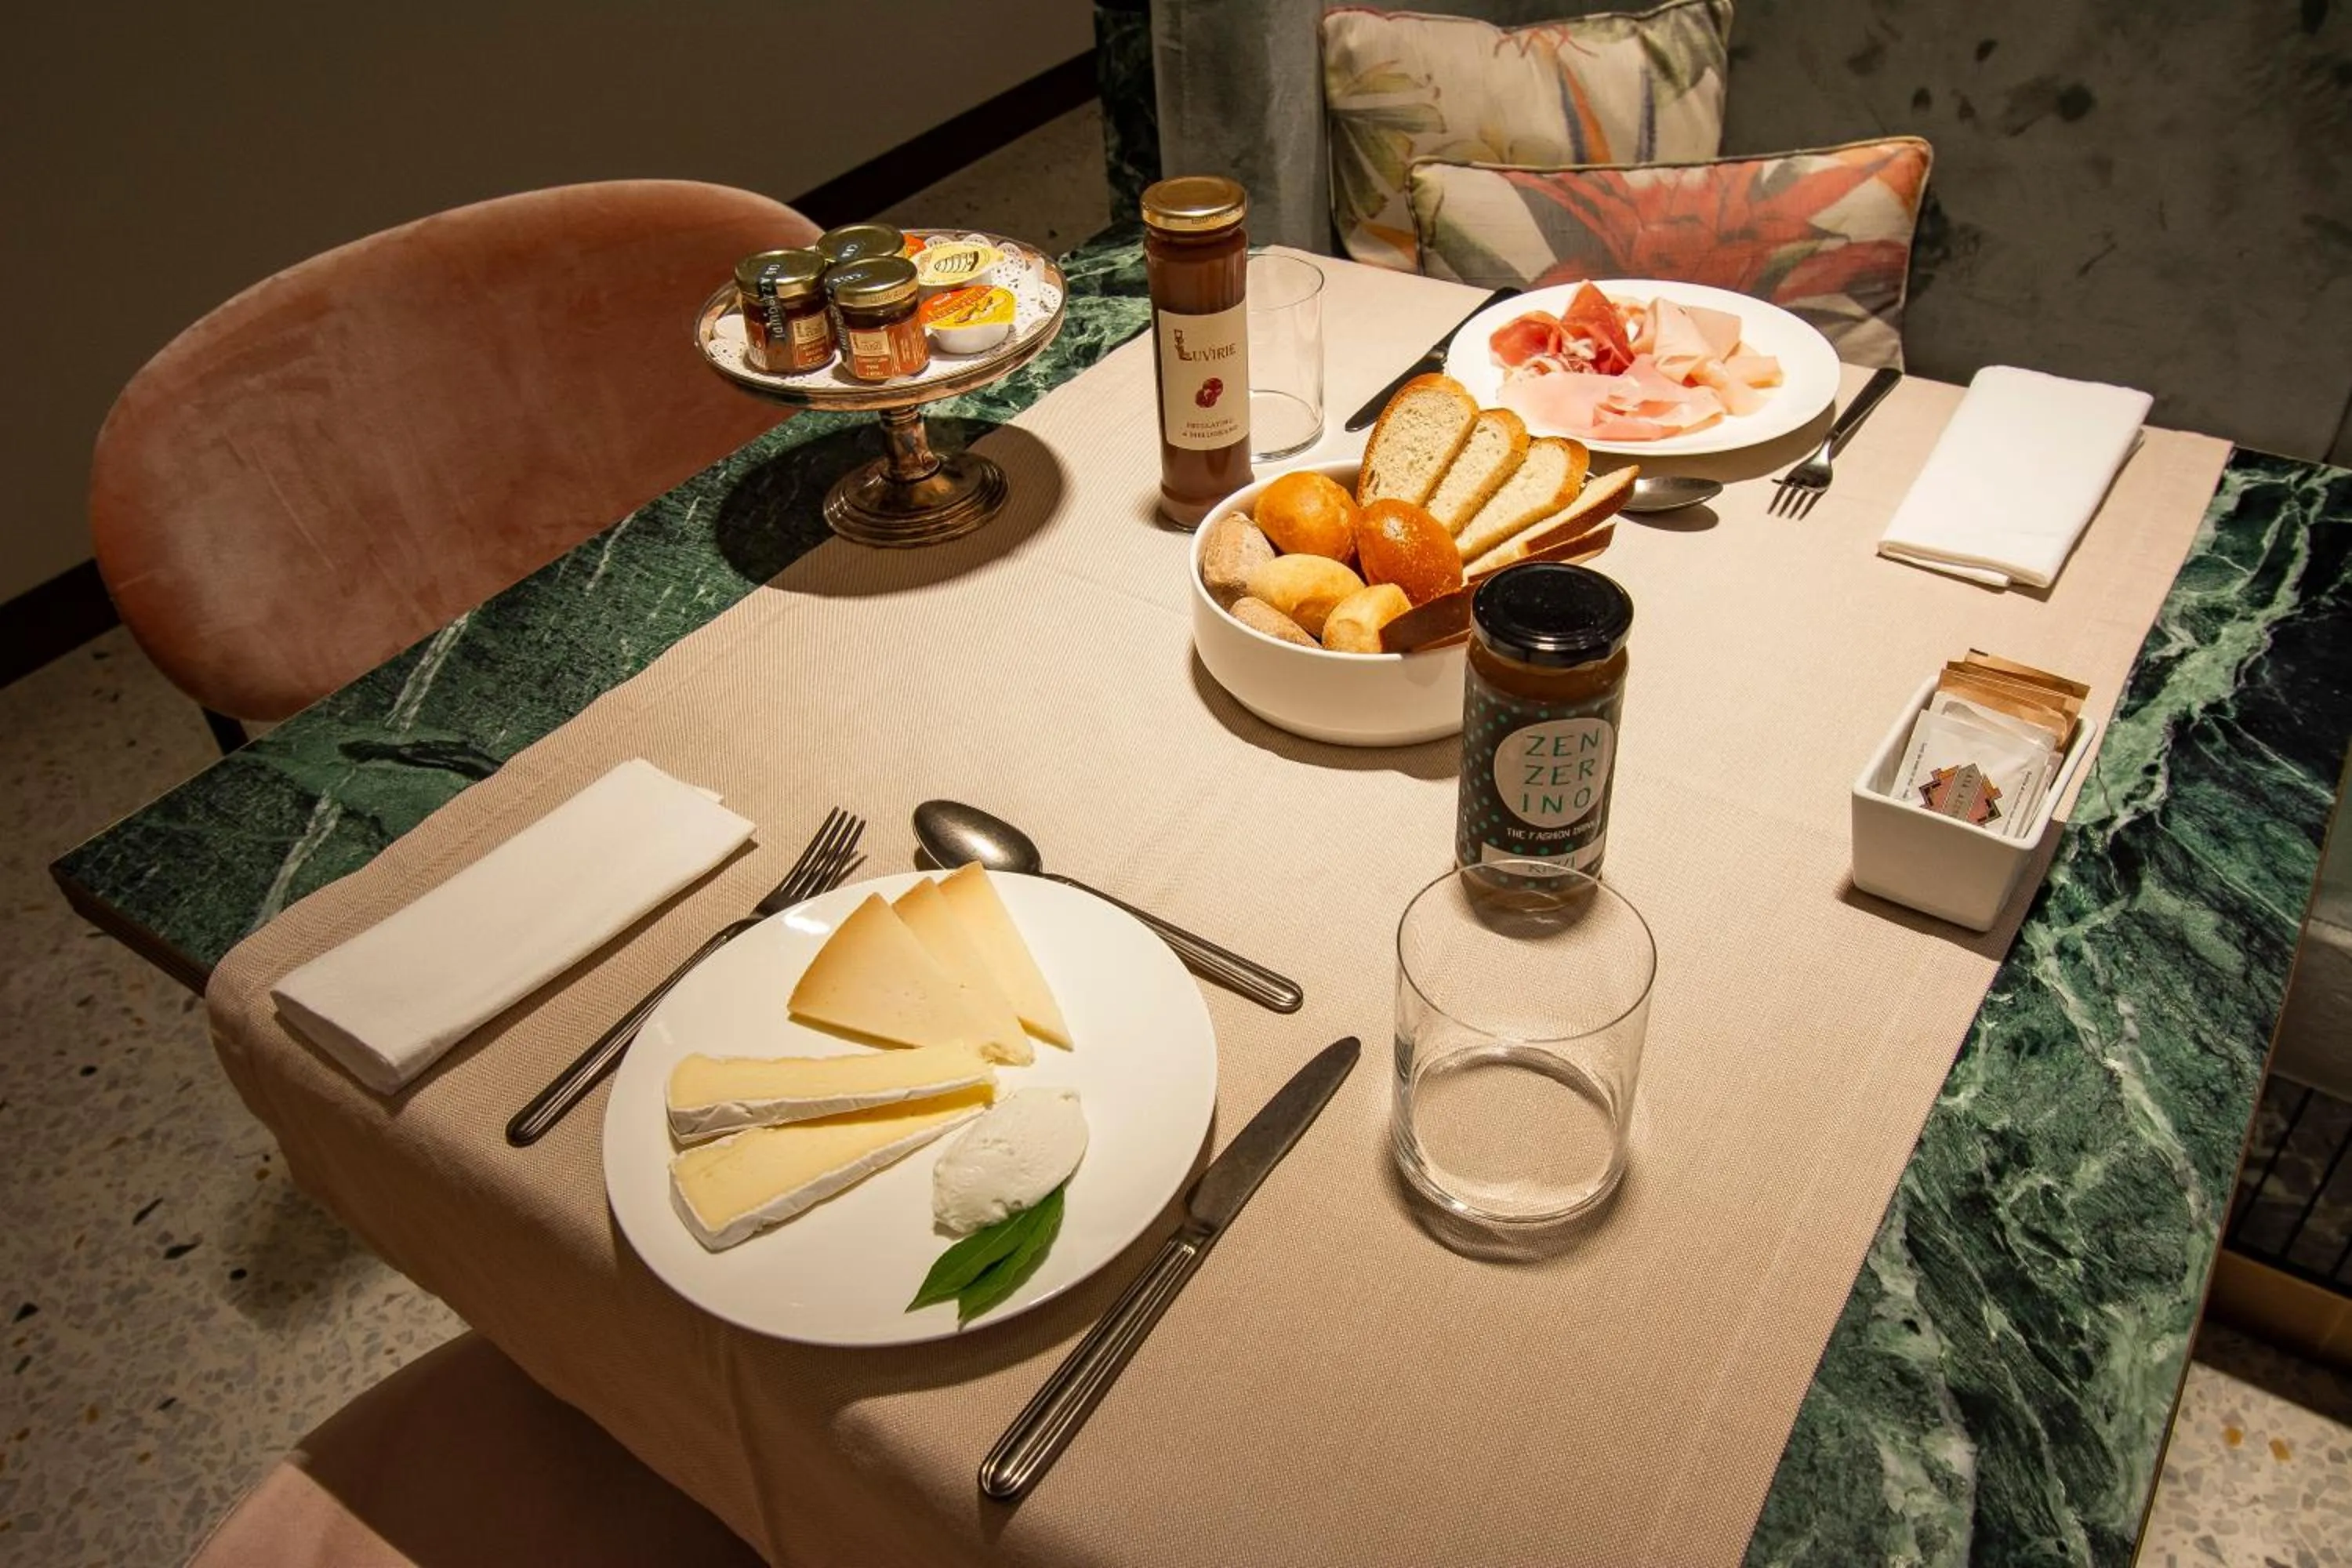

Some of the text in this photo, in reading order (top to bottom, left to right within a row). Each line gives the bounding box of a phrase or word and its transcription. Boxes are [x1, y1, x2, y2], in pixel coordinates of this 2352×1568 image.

[1525, 728, 1599, 757] ZEN
[1524, 758, 1595, 786] ZER
[1522, 787, 1592, 814] INO
[1507, 828, 1526, 840] THE
[1528, 828, 1571, 841] FASHION
